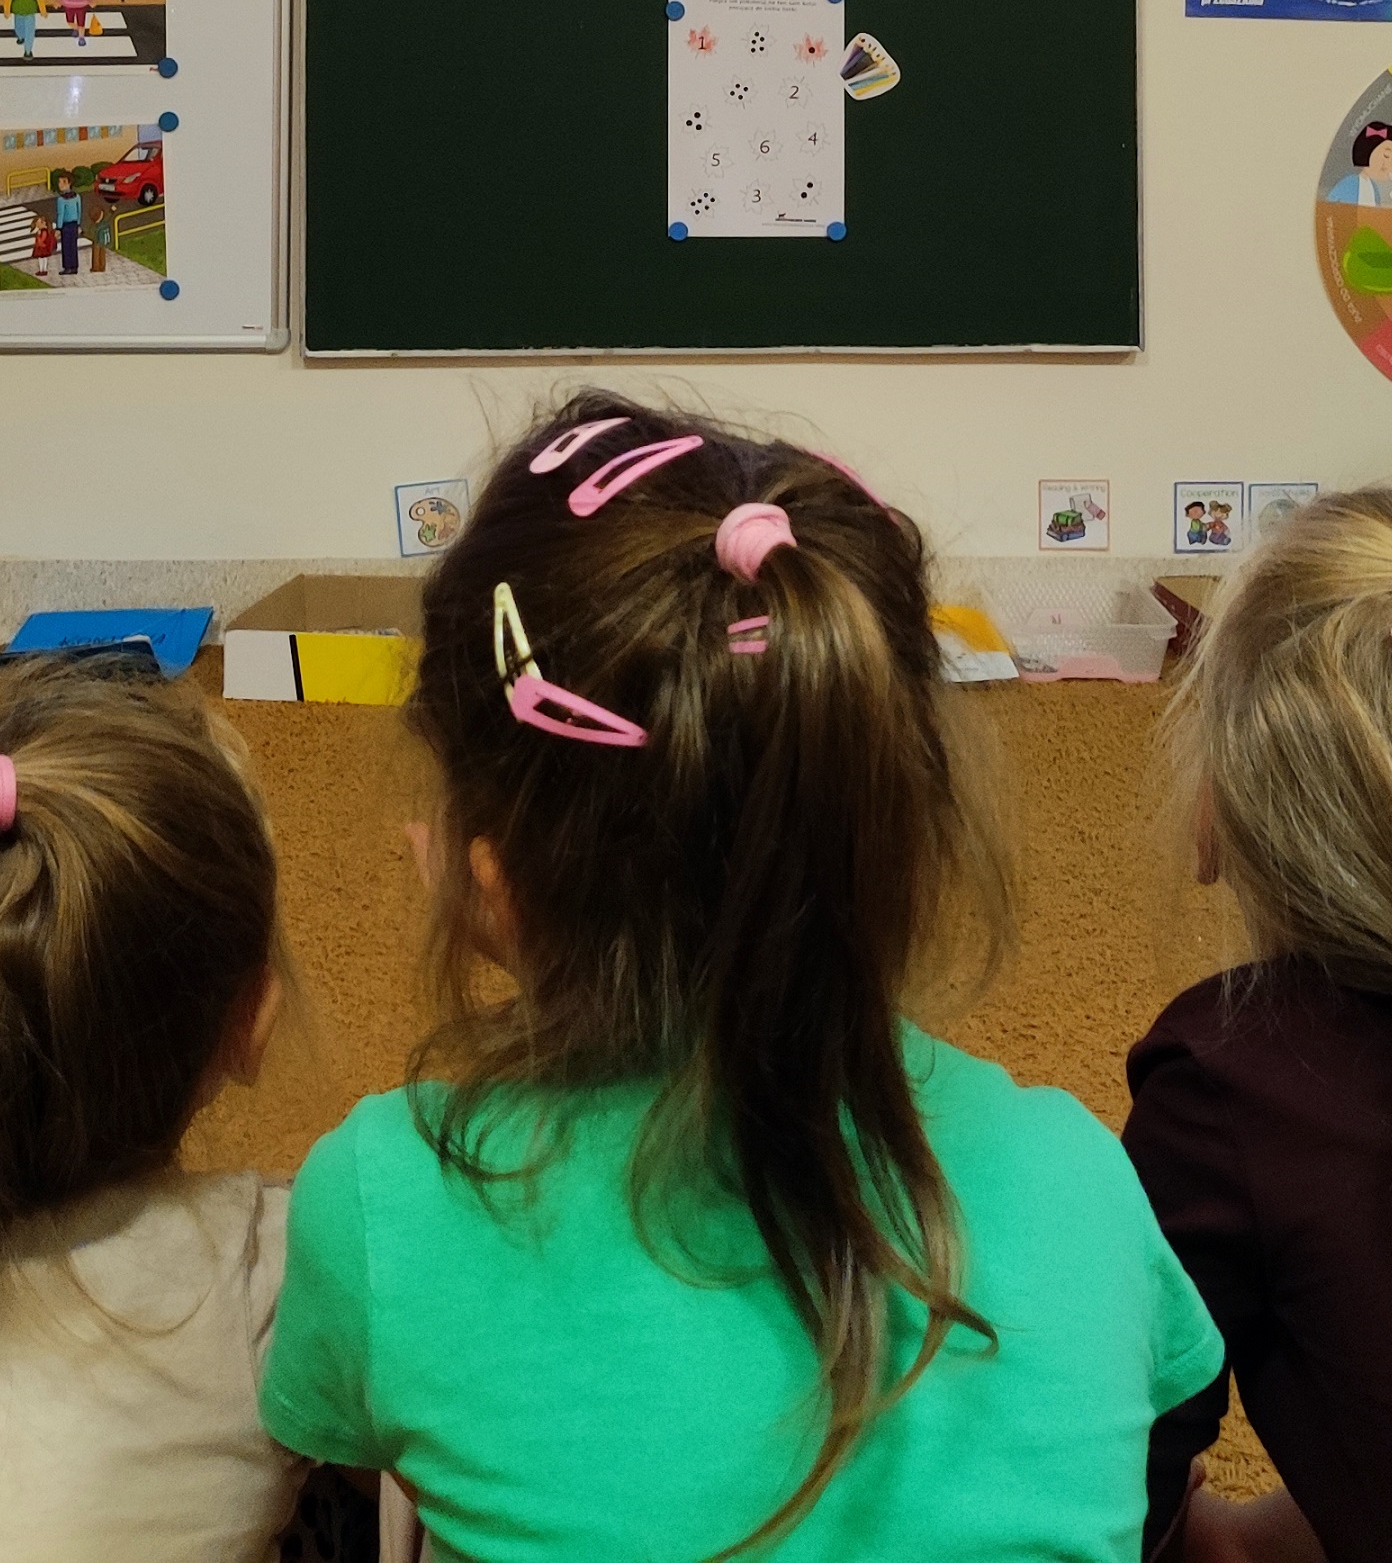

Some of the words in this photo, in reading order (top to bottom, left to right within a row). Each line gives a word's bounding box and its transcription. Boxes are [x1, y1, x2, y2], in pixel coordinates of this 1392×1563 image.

[698, 36, 706, 51] 1
[789, 85, 799, 99] 2
[808, 132, 817, 146] 4
[760, 140, 770, 154] 6
[711, 153, 720, 166] 5
[751, 189, 761, 203] 3
[425, 487, 440, 495] Art
[1180, 489, 1239, 498] Cooperation
